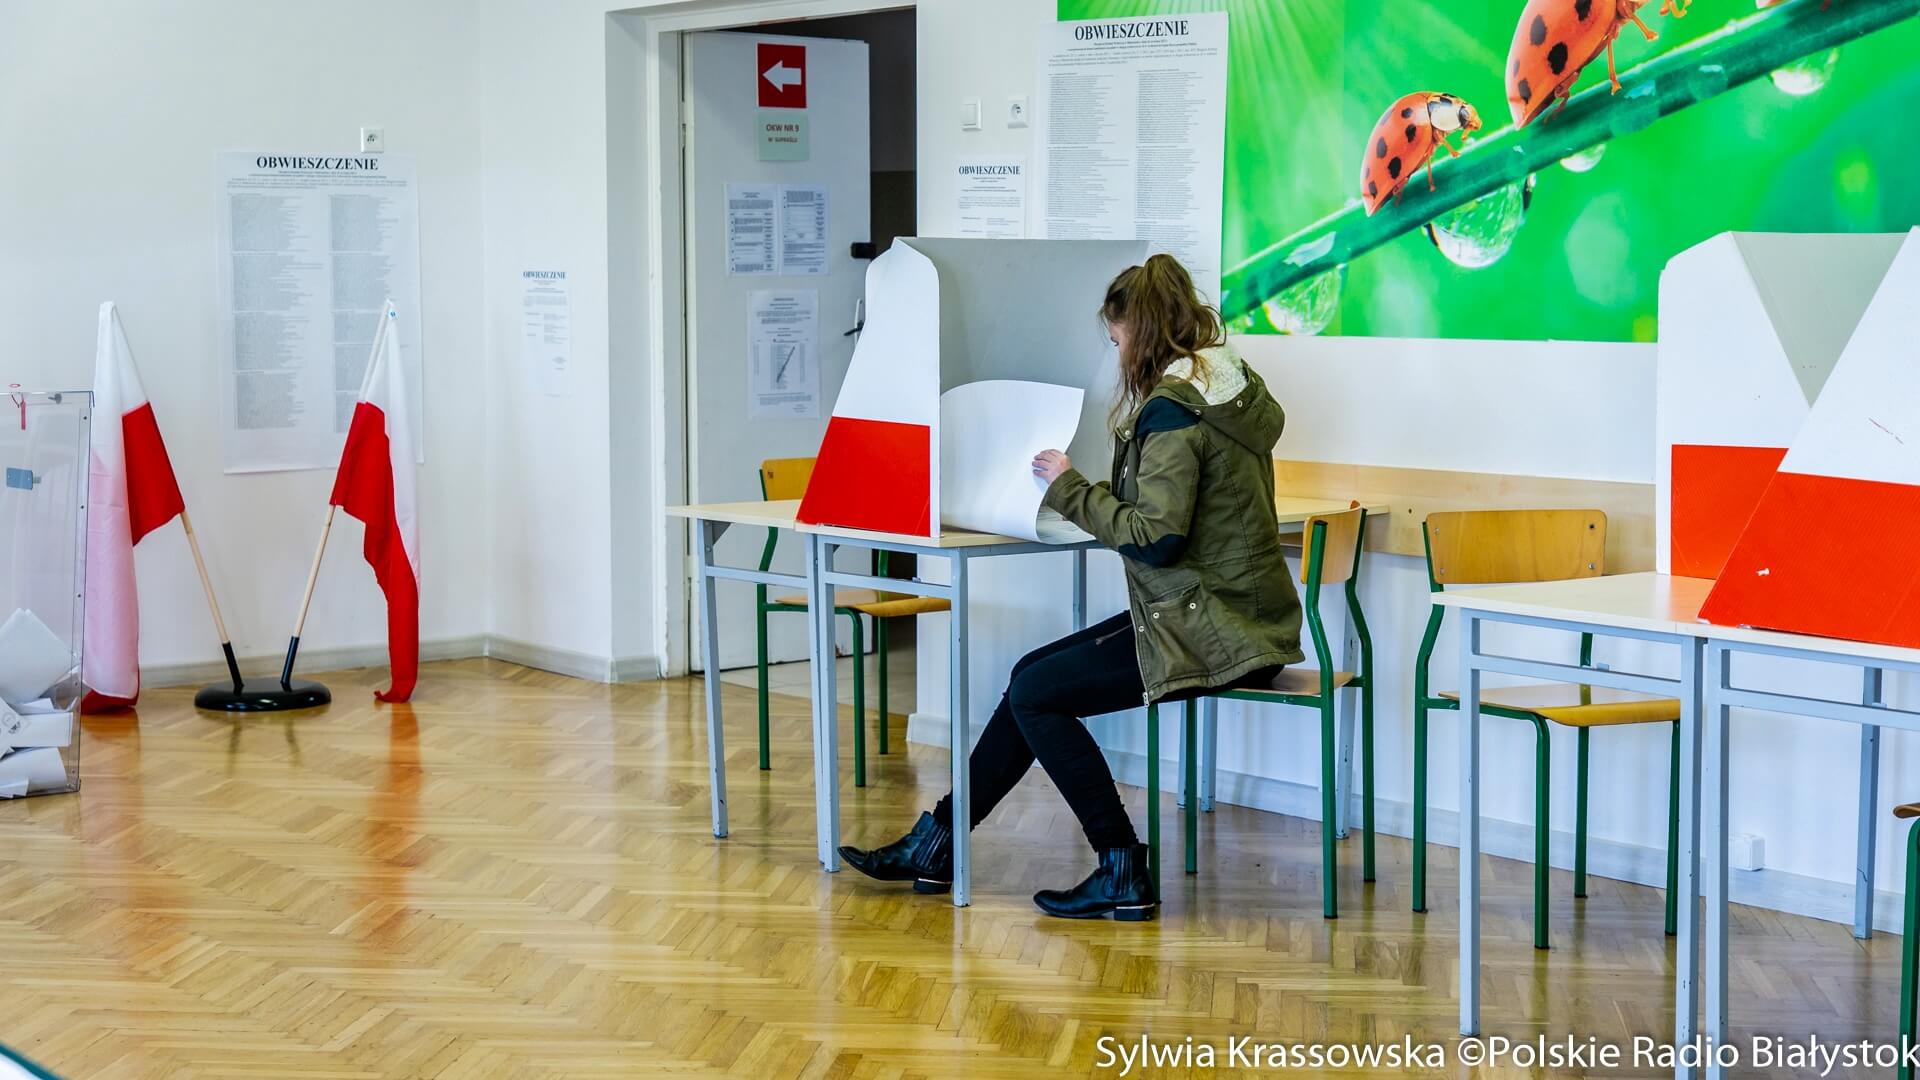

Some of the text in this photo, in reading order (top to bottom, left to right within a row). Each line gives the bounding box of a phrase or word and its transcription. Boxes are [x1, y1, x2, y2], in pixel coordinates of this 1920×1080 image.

[1075, 20, 1189, 41] OBWIESZCZENIE
[766, 123, 783, 132] OKW
[784, 123, 794, 132] NR
[256, 156, 378, 171] OBWIESZCZENIE
[958, 165, 1021, 175] OBWIESZCZENIE
[523, 271, 566, 279] OBWIESZCZENIE
